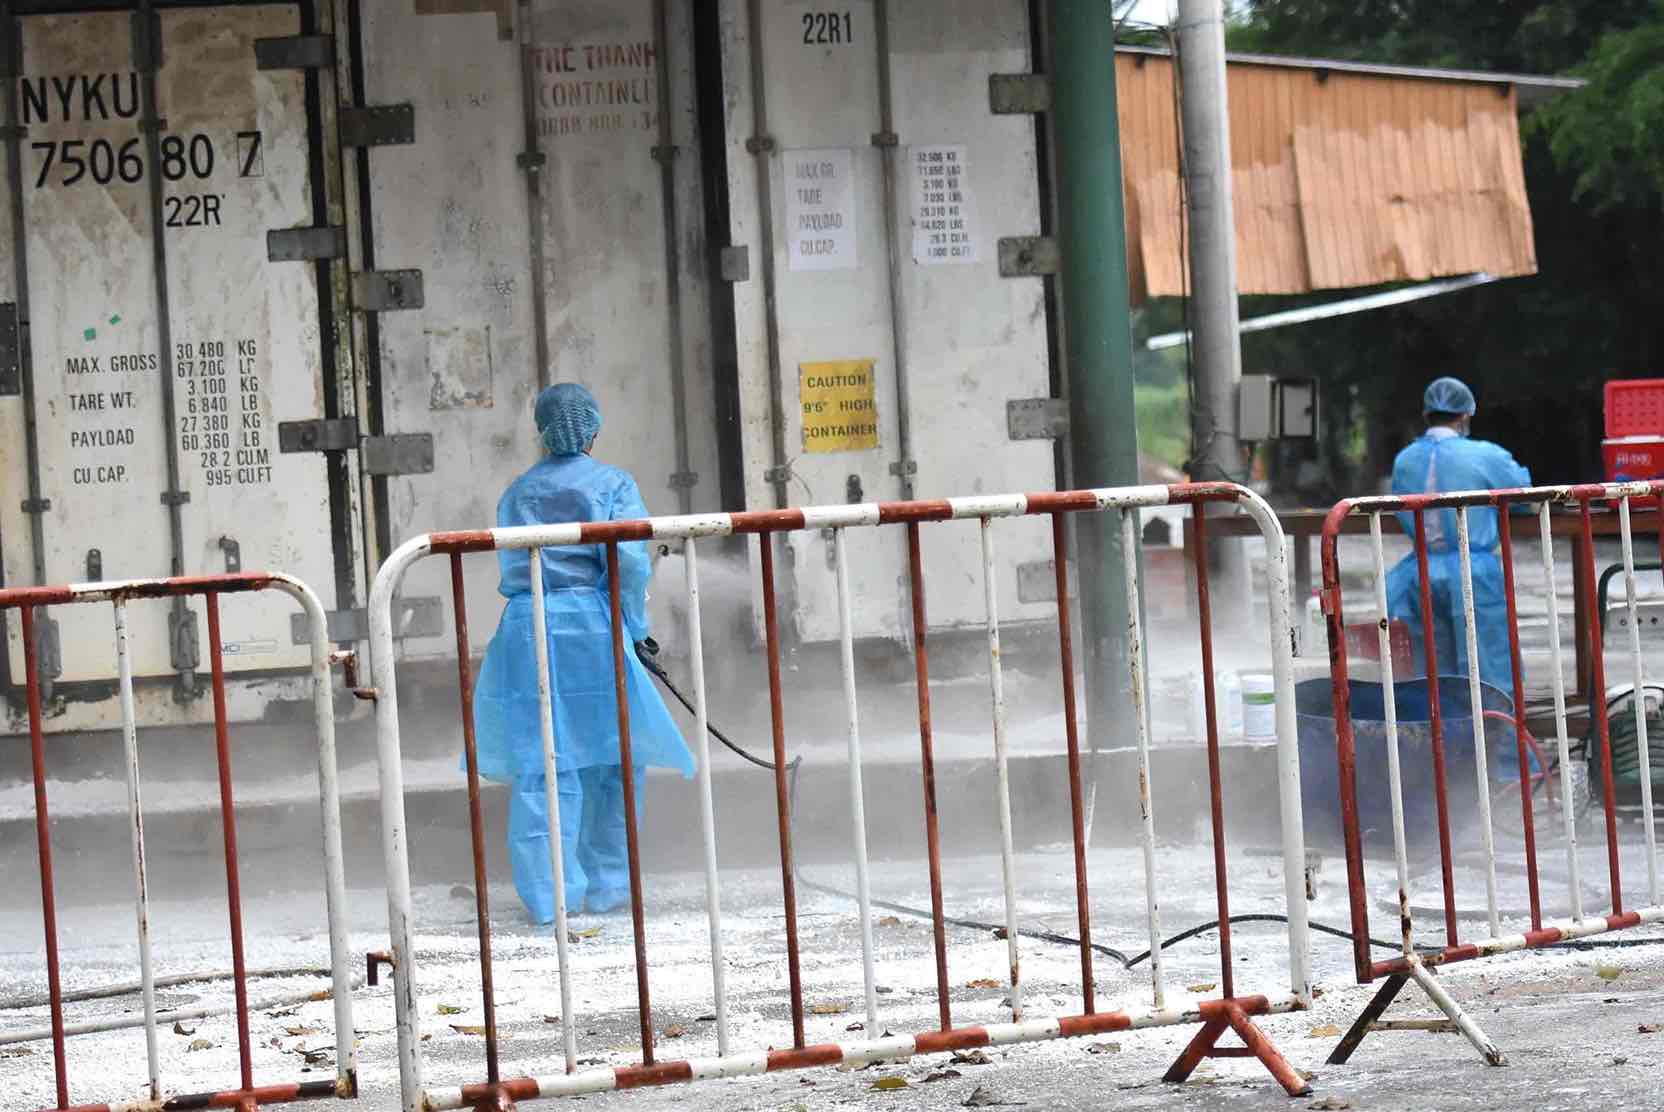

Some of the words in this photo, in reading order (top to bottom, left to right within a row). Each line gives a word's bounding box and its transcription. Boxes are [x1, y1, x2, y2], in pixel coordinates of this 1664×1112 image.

[801, 12, 852, 44] 22R1
[21, 72, 139, 123] NYKU
[164, 194, 225, 227] 22R
[238, 339, 256, 357] KG
[66, 356, 106, 374] MAX.
[110, 353, 157, 372] GROSS
[240, 376, 258, 393] KG
[807, 374, 867, 389] CAUTION
[69, 393, 105, 411] TARE
[110, 391, 136, 409] WT.
[241, 394, 258, 412] LB
[840, 399, 873, 412] HIGH
[242, 412, 260, 429] KG
[71, 428, 134, 448] PAYLOAD
[244, 431, 260, 447] LB
[206, 469, 232, 486] 995
